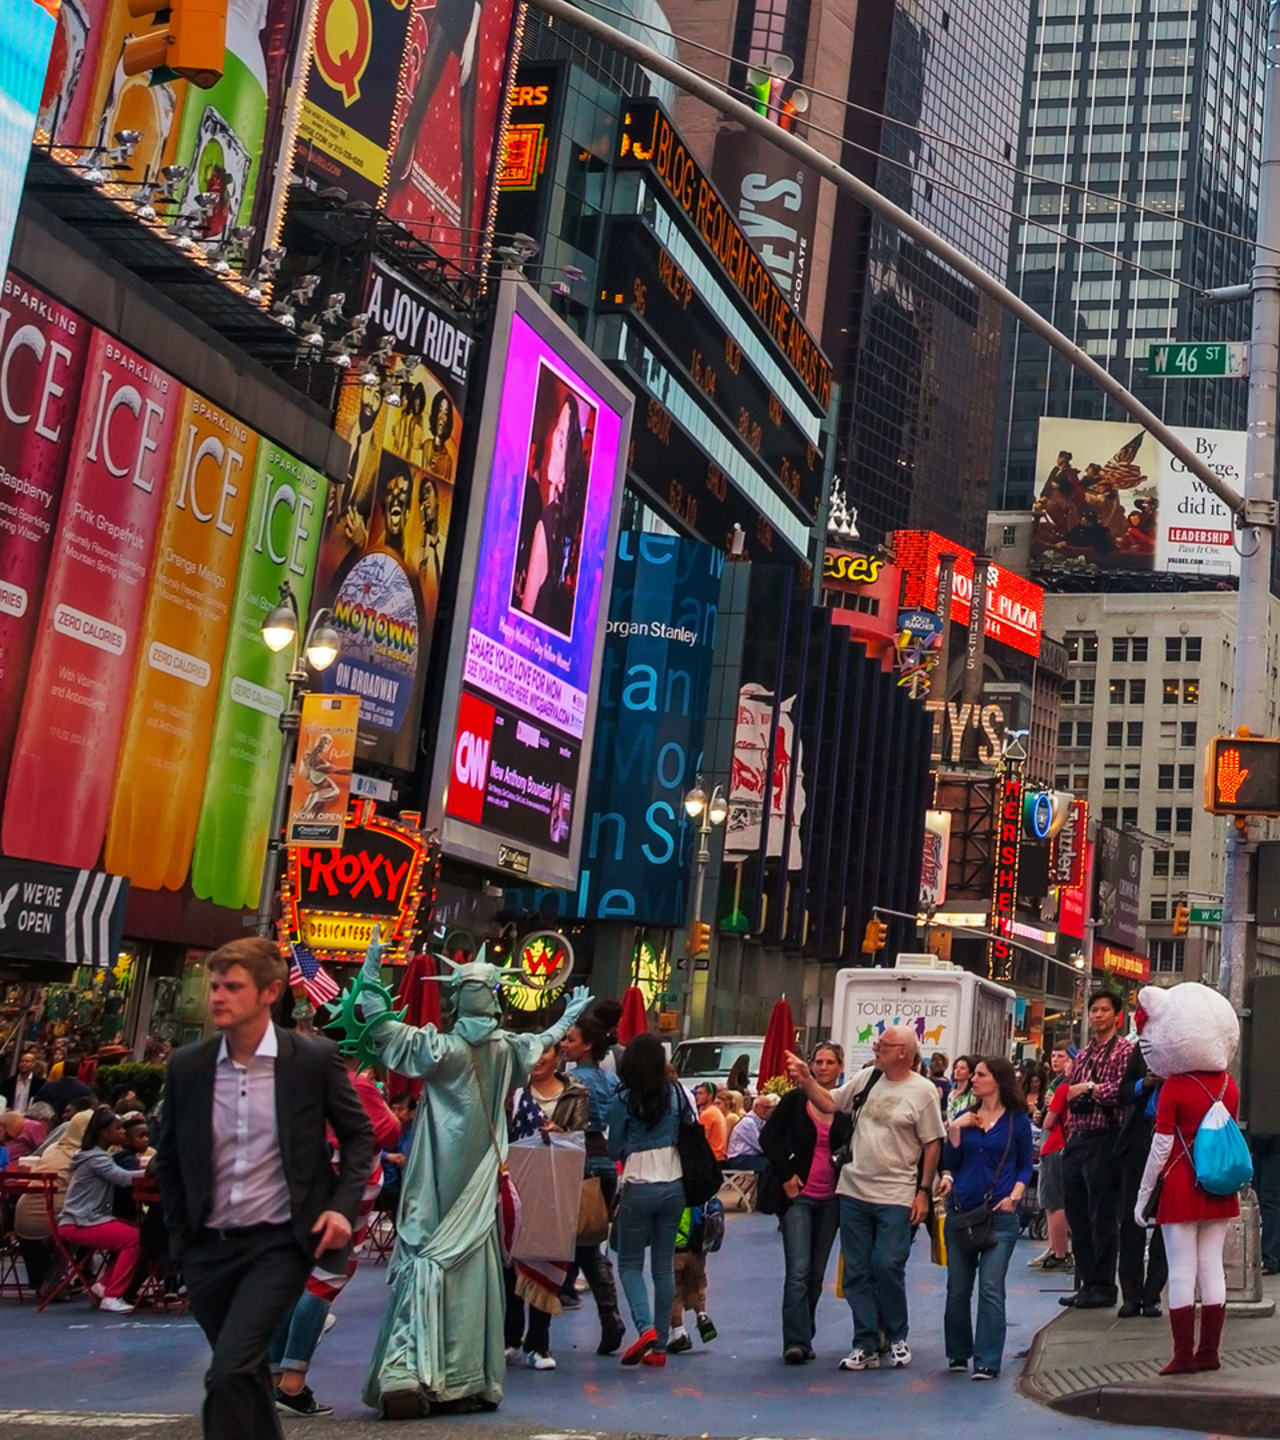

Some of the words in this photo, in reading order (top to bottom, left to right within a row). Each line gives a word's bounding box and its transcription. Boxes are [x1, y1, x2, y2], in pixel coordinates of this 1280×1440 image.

[656, 121, 698, 218] BLOG:
[697, 179, 747, 289] REQUIEM
[748, 260, 771, 323] FOR
[770, 286, 788, 350] THE
[788, 310, 819, 392] ANGUS
[3, 279, 77, 336] SPARKLING
[105, 343, 169, 394] SPARKLING
[1154, 347, 1169, 372] W
[1175, 347, 1198, 373] 46
[1205, 346, 1221, 361] ST
[87, 368, 165, 493] ICE
[193, 399, 248, 443] SPARKLING
[1195, 436, 1217, 459] By
[176, 423, 244, 536] ICE
[254, 472, 313, 576] ICE
[1177, 496, 1206, 516] did
[1210, 498, 1227, 517] it.
[1170, 529, 1231, 544] LEADERSHIP
[58, 610, 81, 631] ZERO
[82, 620, 123, 649] CALORIES
[331, 595, 417, 653] MOTOWN
[999, 594, 1038, 632] PLAZA
[335, 662, 349, 689] ON
[350, 666, 400, 705] BROADWAY
[456, 730, 489, 791] CNN
[293, 811, 316, 821] NOW
[317, 812, 344, 822] OPEN
[23, 881, 63, 907] WE'RE
[301, 845, 409, 902] ROXY
[18, 910, 53, 934] OPEN
[856, 1002, 893, 1017] TOUR
[896, 1003, 921, 1017] FOR
[925, 1004, 948, 1018] LIFE
